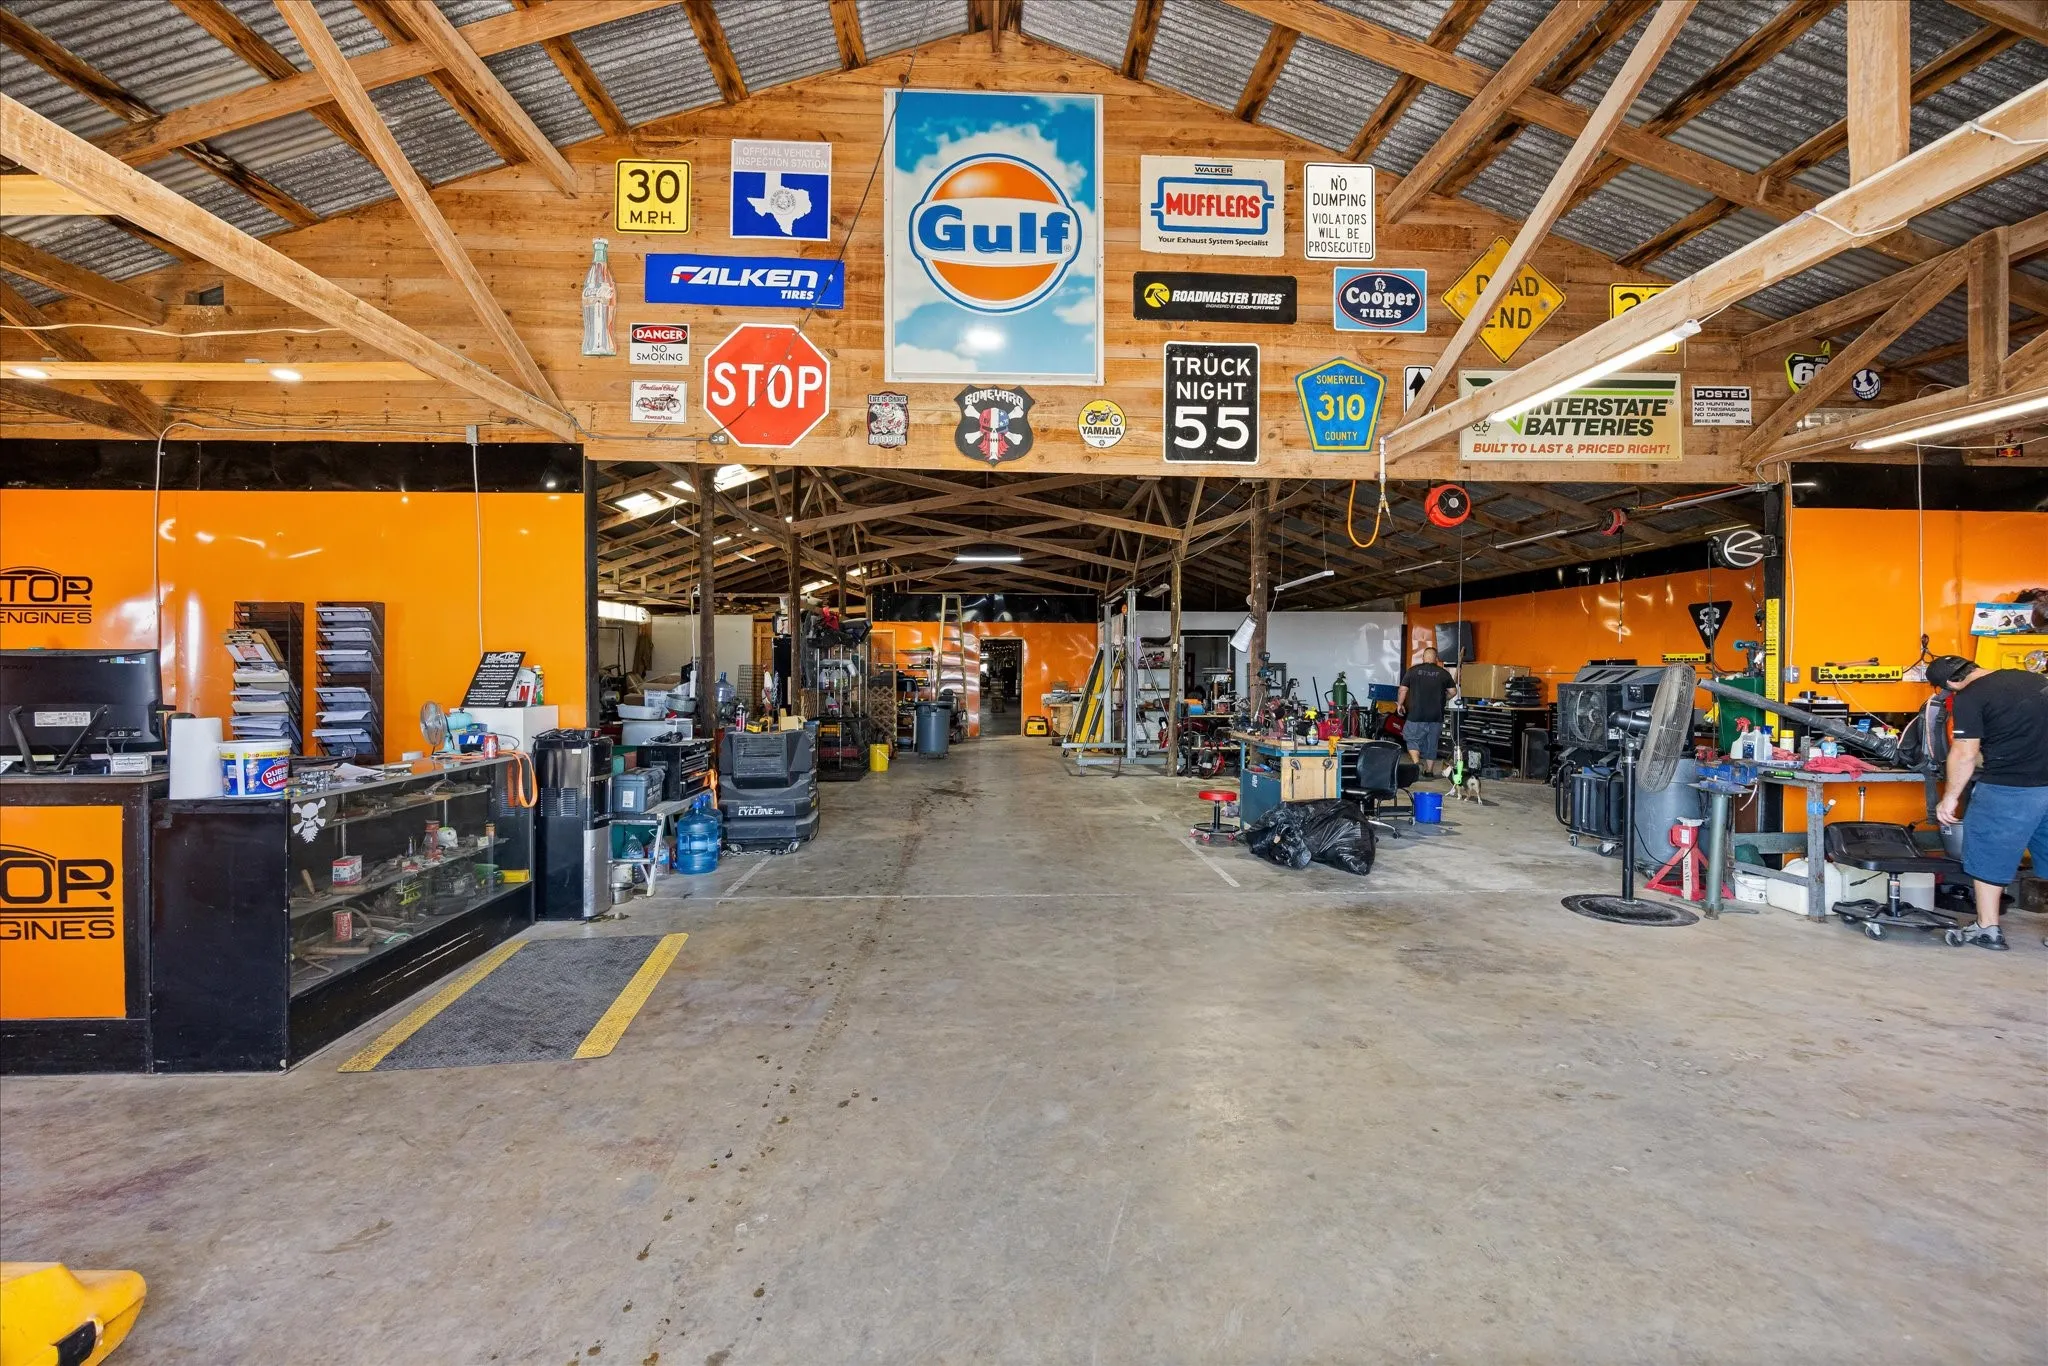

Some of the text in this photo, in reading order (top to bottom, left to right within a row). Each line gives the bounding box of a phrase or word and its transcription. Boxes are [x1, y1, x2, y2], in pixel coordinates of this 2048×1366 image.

[743, 147, 821, 158] OFFICIAL VEHICLE
[736, 156, 828, 169] INSPECTION STATION
[1194, 166, 1233, 174] WALKER
[627, 169, 680, 204] 30
[1330, 176, 1347, 191] NO
[1165, 191, 1261, 219] MUFFLERS
[1312, 192, 1367, 207] DUMPING
[1312, 213, 1367, 226] VIOLATORS
[917, 204, 1071, 254] Gulf
[1318, 227, 1359, 240] WILL BE
[1158, 235, 1269, 247] Your Exhaust System Specialist
[1309, 240, 1371, 254] PROSECUTED
[669, 265, 819, 289] FALKEN
[1476, 274, 1540, 297] DAD
[780, 289, 814, 300] TIRES
[1172, 289, 1283, 306] ROADMASTER TIRES
[1345, 286, 1416, 307] Cooper
[1360, 307, 1402, 319] TIRES
[635, 329, 683, 341] DANGER
[651, 344, 668, 353] NO
[636, 352, 683, 362] SMOKING
[1172, 356, 1251, 377] TRUCK
[711, 362, 823, 409] STOP
[1316, 374, 1366, 385] SOMERVELL
[640, 383, 680, 392] Indian Chief
[1176, 382, 1247, 401] NIGHT
[964, 388, 1024, 410] BONEYARD
[1696, 390, 1748, 399] POSTED
[1316, 394, 1366, 421] 310
[1082, 426, 1122, 436] YAMAHA
[1173, 406, 1250, 450] 55
[1524, 417, 1655, 437] BATTERIES
[1324, 430, 1358, 441] COUNTY
[1473, 442, 1671, 455] BUILT TO LAST & PRICED RIGHT!
[738, 807, 774, 816] CYCLONE
